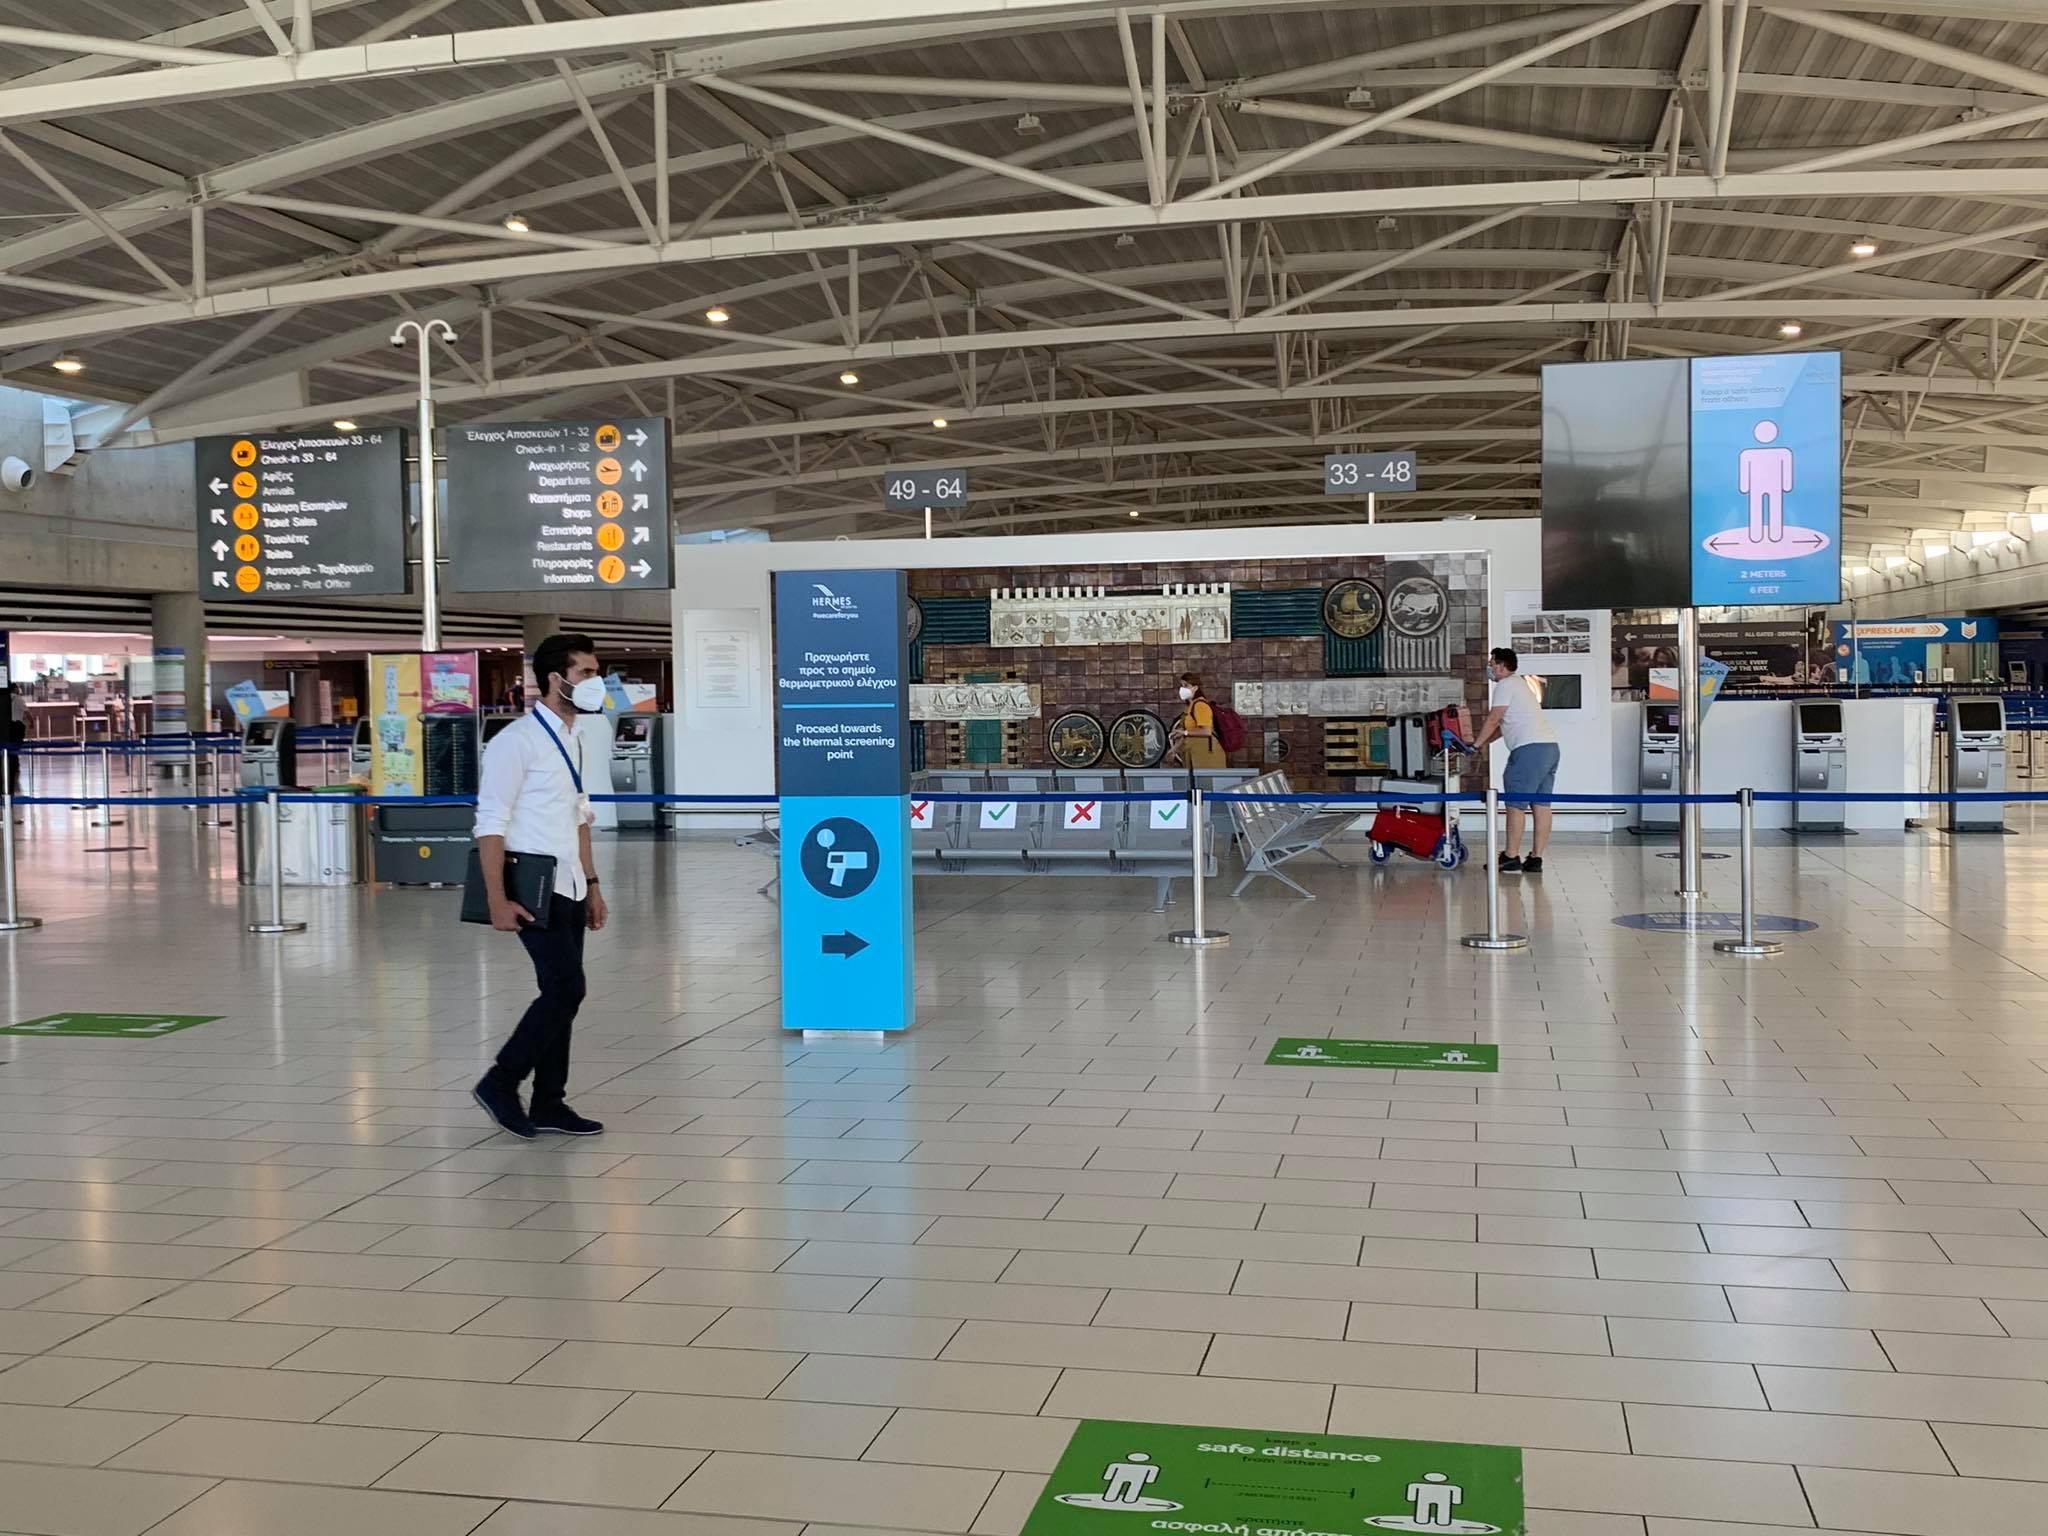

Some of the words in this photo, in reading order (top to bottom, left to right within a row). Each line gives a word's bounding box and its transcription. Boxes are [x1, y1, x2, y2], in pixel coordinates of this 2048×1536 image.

[506, 429, 560, 439] Αποσκευών
[563, 428, 568, 437] 1
[578, 427, 590, 437] 32
[351, 435, 363, 445] 33
[370, 434, 382, 444] 64
[515, 444, 557, 454] Check-in
[560, 444, 565, 452] 1
[578, 443, 590, 452] 32
[261, 454, 300, 464] Check-in
[302, 453, 314, 463] 33
[325, 452, 337, 462] 64
[1330, 463, 1359, 485] 33
[1381, 460, 1411, 482] 48
[539, 476, 591, 487] Departures
[262, 486, 295, 496] Arrivals
[889, 479, 916, 500] 49
[936, 478, 962, 499] 64
[562, 508, 592, 519] Shops
[263, 518, 290, 528] Ticket
[292, 517, 318, 527] Sales
[537, 541, 593, 551] Restaurants
[264, 549, 294, 559] Toilets
[543, 574, 594, 583] Information
[1741, 570, 1748, 578] 2
[1750, 570, 1787, 578] METERS
[265, 581, 291, 591] Police
[302, 580, 321, 589] Post
[325, 579, 351, 589] Office
[1757, 586, 1780, 594] FEET
[812, 597, 851, 606] HERMES
[805, 652, 870, 663] Προχωρήστε
[799, 667, 825, 676] προς
[827, 666, 840, 675] το
[841, 664, 876, 676] σημείο
[779, 678, 854, 690] θερμομετρικού
[856, 677, 897, 689] ελέγχου
[796, 724, 839, 734] Proceed
[840, 723, 882, 733] towards
[783, 737, 801, 747] the
[803, 736, 843, 747] thermal
[844, 736, 895, 748] screening
[827, 750, 854, 761] point
[1197, 1442, 1256, 1455] safe
[1262, 1445, 1382, 1463] distance
[1151, 1519, 1250, 1536] ασφαλή
